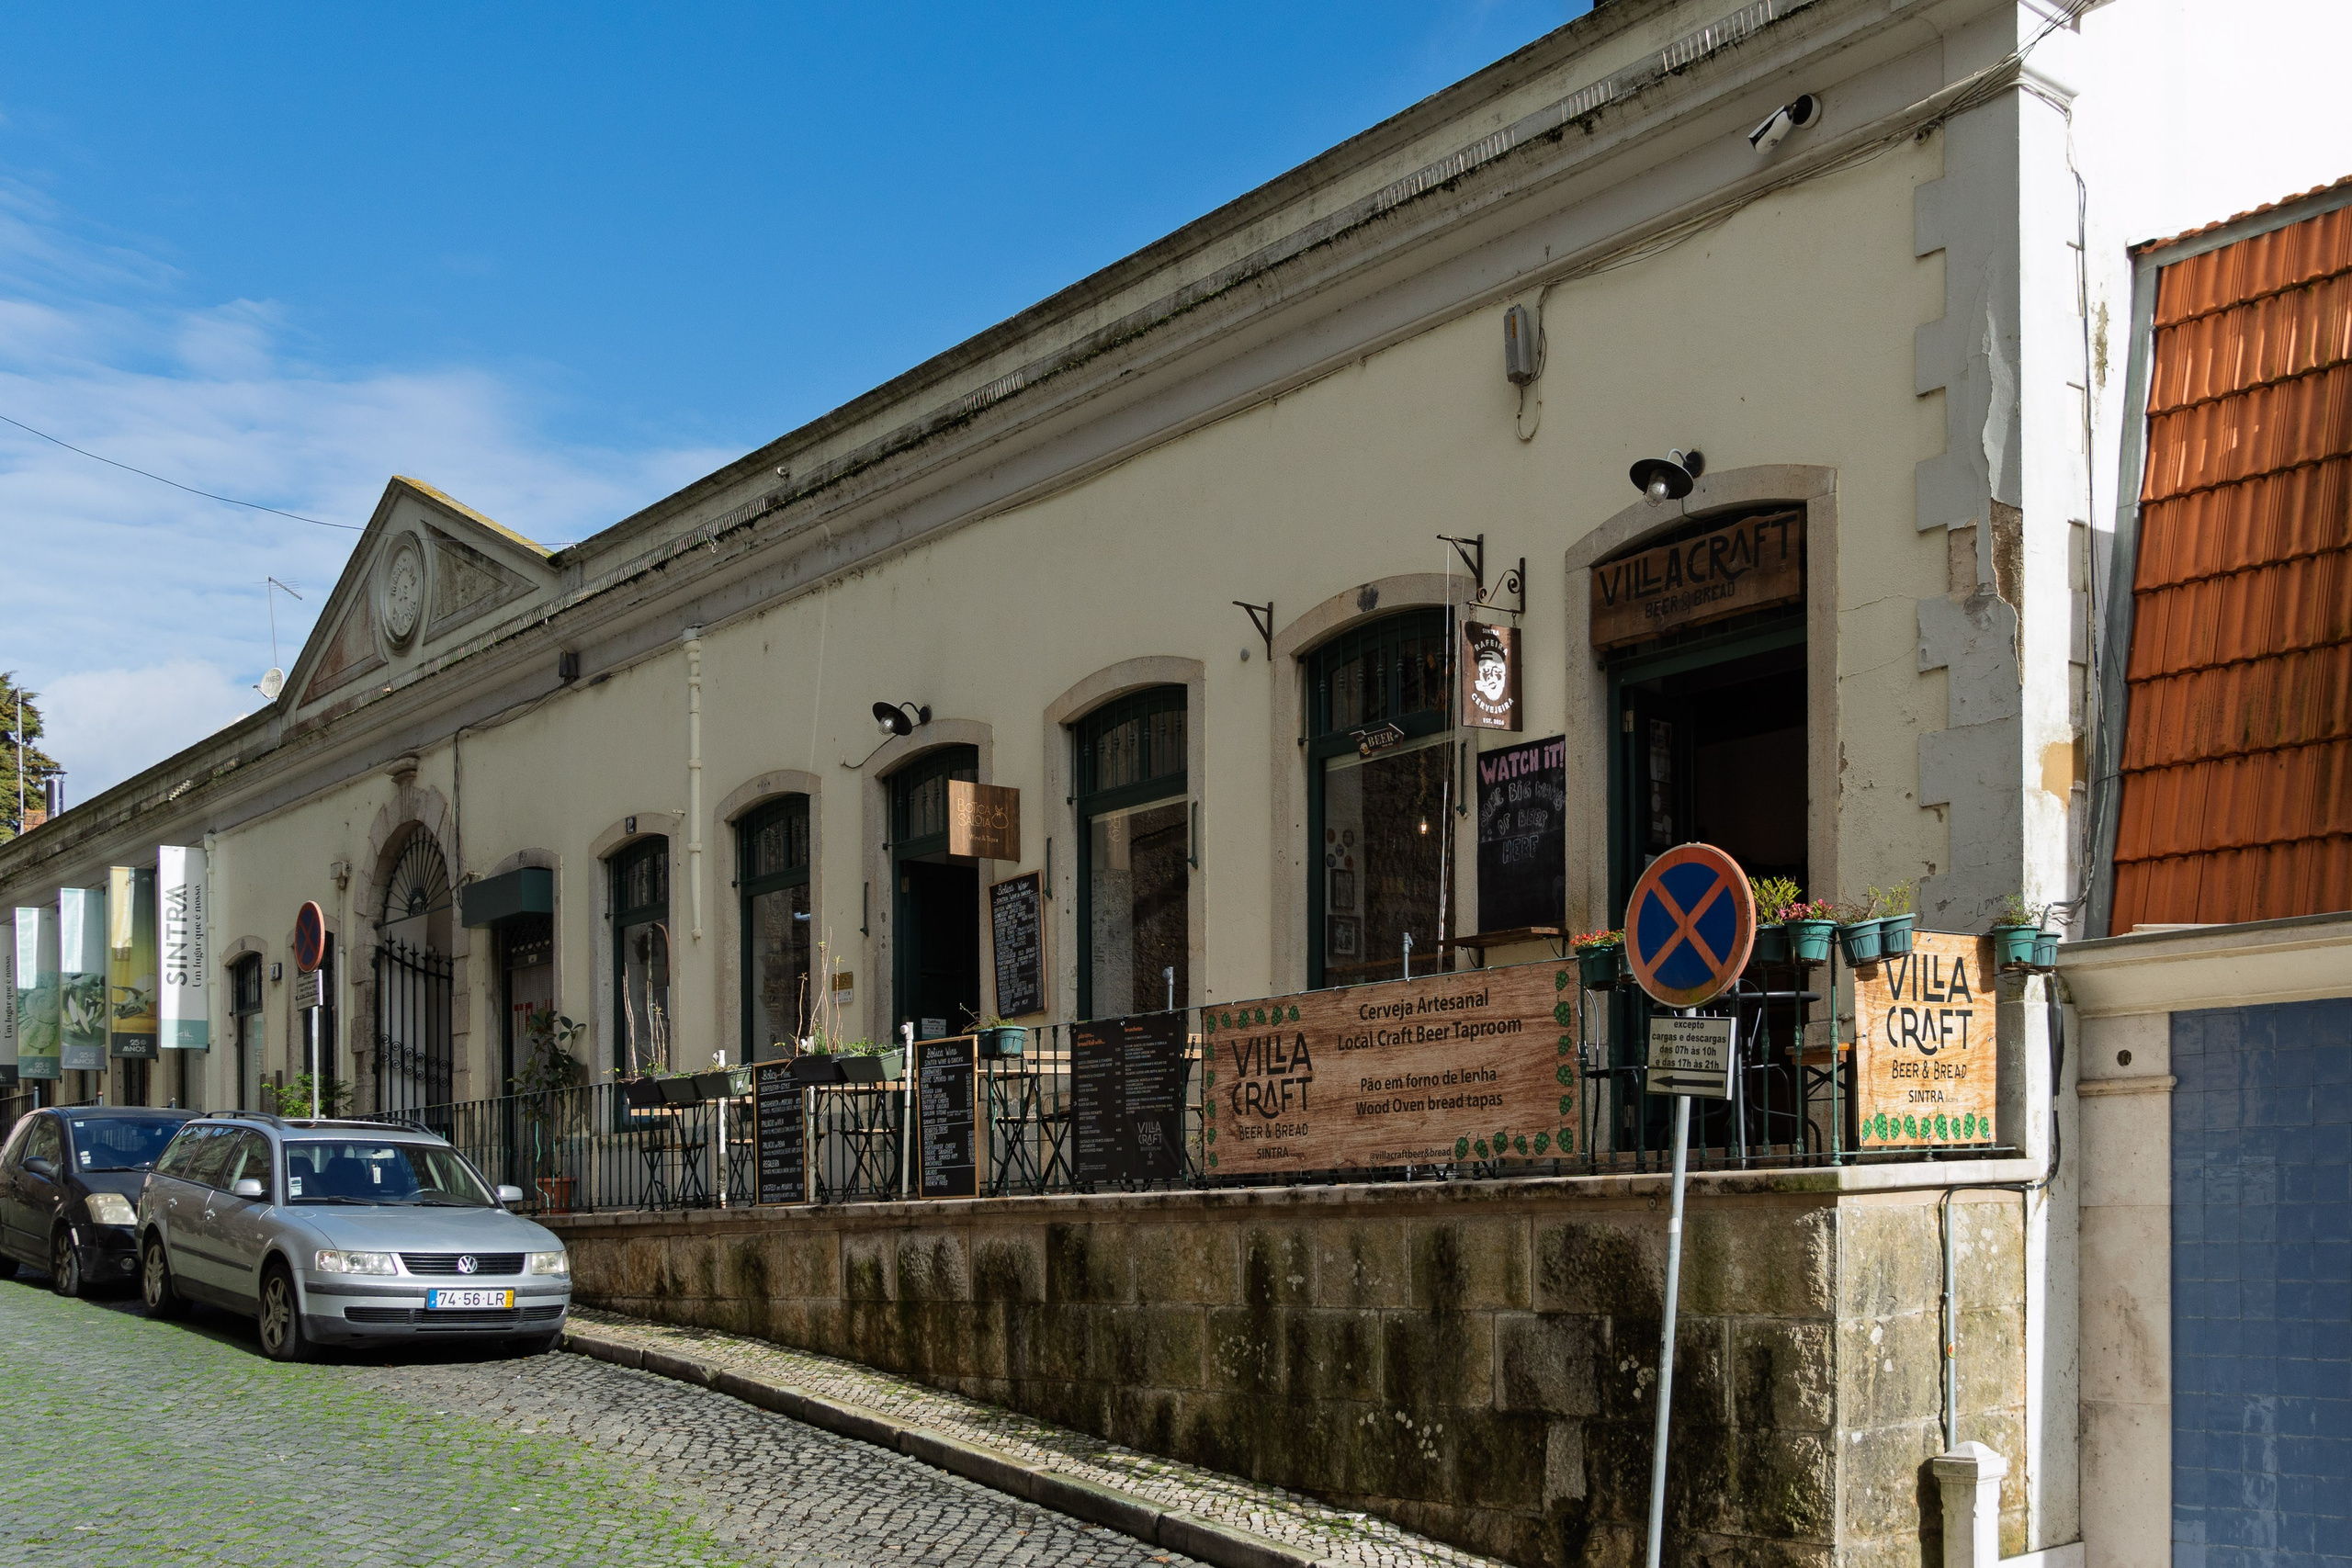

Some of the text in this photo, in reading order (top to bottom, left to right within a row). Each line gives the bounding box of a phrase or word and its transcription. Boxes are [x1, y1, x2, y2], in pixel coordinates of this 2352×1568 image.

[1645, 581, 1736, 619] BEER & BREAD
[1474, 639, 1508, 657] RAFEIRA
[1472, 693, 1514, 714] CERVEJEIRA
[1368, 731, 1394, 747] BEER
[1480, 749, 1539, 784] WATCH
[1498, 808, 1548, 835] OF BEER
[1502, 835, 1539, 863] HERE
[165, 883, 187, 987] SINTRA
[195, 921, 204, 940] que
[193, 942, 204, 968] lugar
[1885, 953, 1973, 1003] VILLA
[1360, 988, 1489, 1021] Cerveja Artesanal
[1338, 1019, 1521, 1051] Local Craft Beer Taproom
[1674, 1021, 1704, 1031] excepto
[1886, 1006, 1973, 1055] CRAFT
[1652, 1032, 1677, 1043] cargas
[1686, 1033, 1726, 1044] descargas
[1231, 1032, 1313, 1077] VILLA
[1659, 1044, 1716, 1056] das 07h às 10h
[1662, 1057, 1675, 1066] das
[1678, 1059, 1691, 1067] 17h
[1693, 1059, 1702, 1068] às
[1704, 1060, 1719, 1069] 21h
[1922, 1060, 1929, 1079] &
[1361, 1066, 1497, 1092] Pão em forno de lenha
[1232, 1077, 1313, 1119] CRAFT
[1356, 1093, 1502, 1115] Wood Oven bread tapas
[1908, 1089, 1944, 1103] SINTRA
[1137, 1121, 1162, 1134] VILLA
[1265, 1123, 1272, 1138] &
[1138, 1134, 1162, 1145] CRAFT
[1257, 1147, 1289, 1159] SINTRA
[1370, 1146, 1452, 1160] @villacraftbeer&bread
